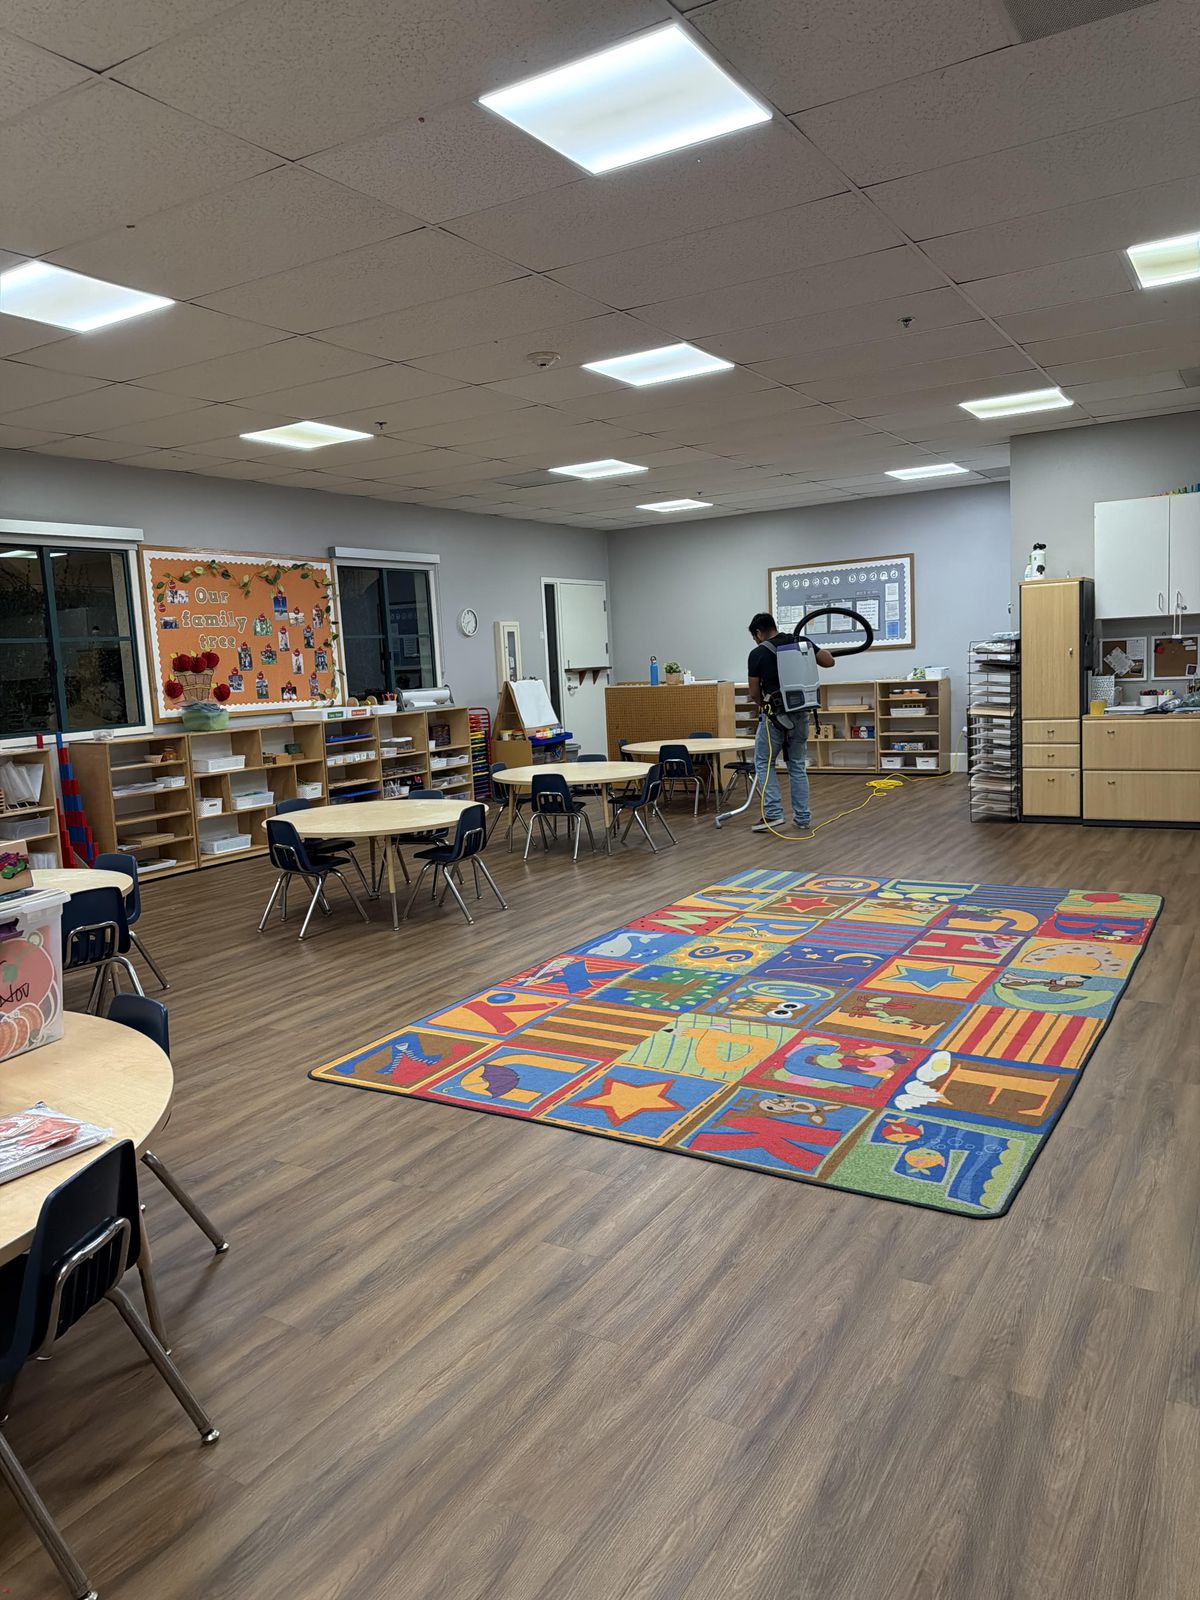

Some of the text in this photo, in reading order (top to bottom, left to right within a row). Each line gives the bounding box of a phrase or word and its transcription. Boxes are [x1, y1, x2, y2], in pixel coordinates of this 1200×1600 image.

[195, 587, 230, 604] Our
[182, 610, 247, 633] family
[199, 634, 236, 649] tree
[718, 916, 821, 936] R
[1054, 914, 1145, 935] B
[688, 945, 753, 962] S
[908, 932, 1007, 959] H
[462, 1000, 559, 1035] Y
[683, 1028, 777, 1072] P
[460, 1054, 592, 1103] U
[939, 1064, 1060, 1116] E
[688, 1109, 843, 1171] K
